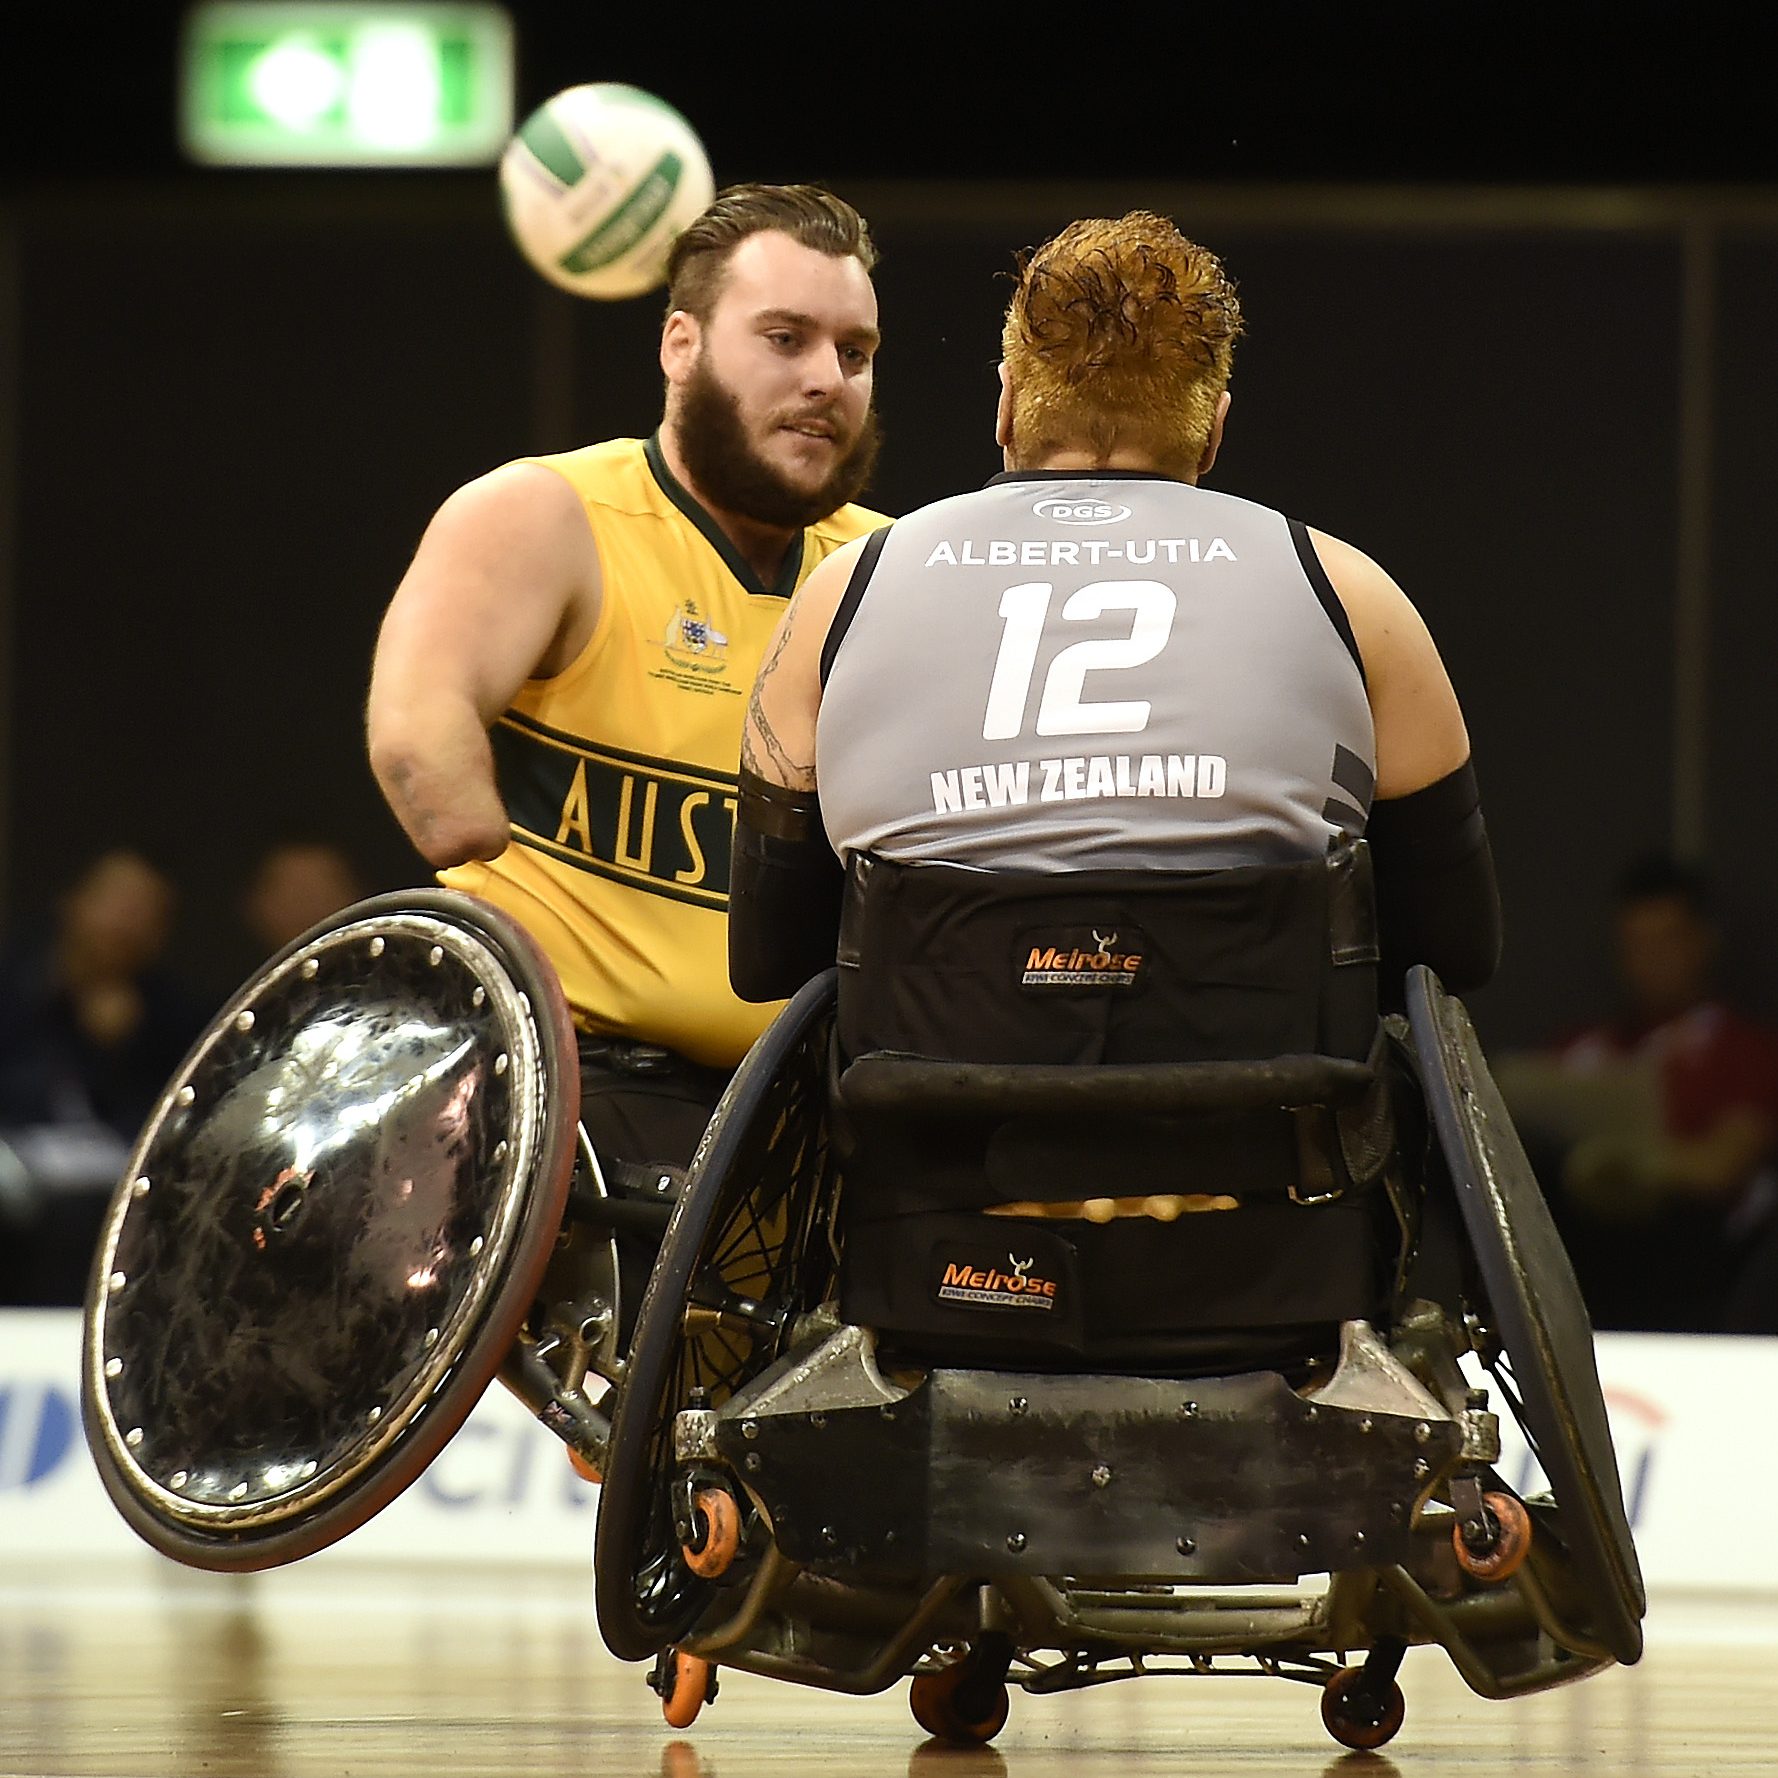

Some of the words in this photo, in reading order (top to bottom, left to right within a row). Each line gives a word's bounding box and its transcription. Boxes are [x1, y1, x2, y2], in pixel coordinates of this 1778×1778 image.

[1051, 504, 1113, 519] DGS
[924, 537, 1238, 568] ALBERT-UTIA
[982, 579, 1178, 741] 12
[930, 761, 1030, 815] NEW
[1039, 755, 1227, 803] ZEALAND
[1026, 947, 1142, 971] Melrose
[942, 1263, 1057, 1297] Melrose
